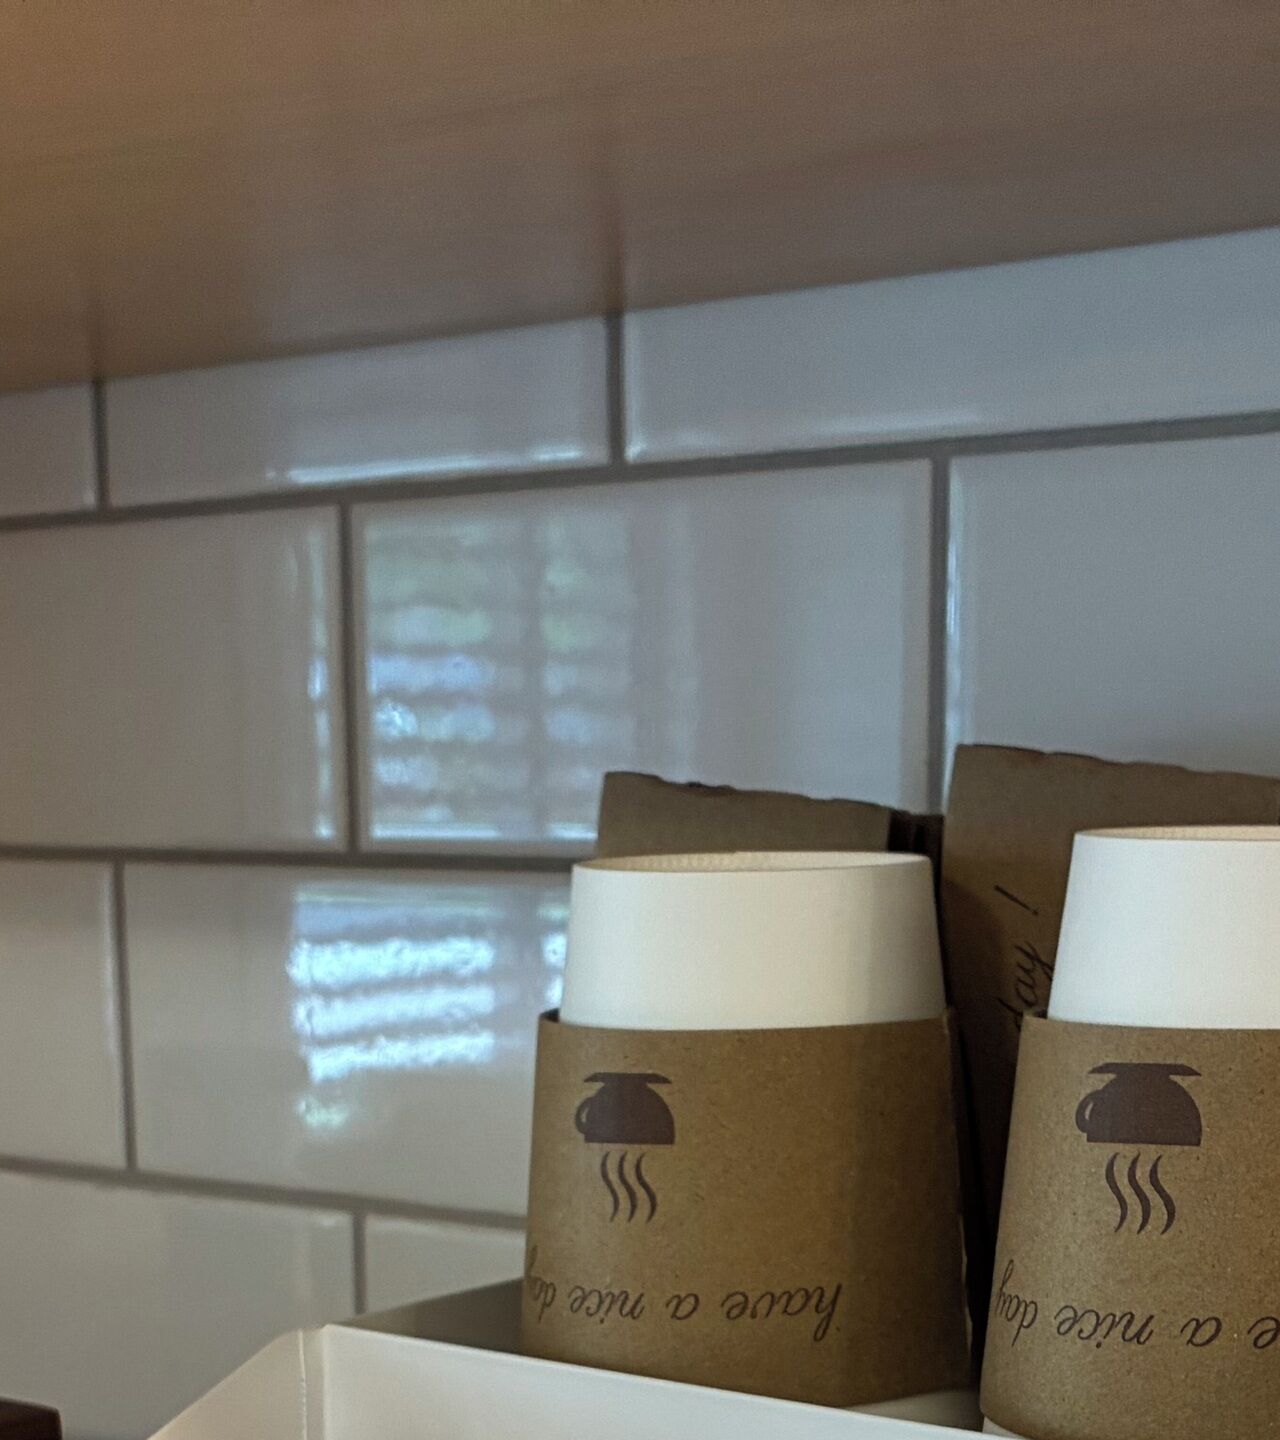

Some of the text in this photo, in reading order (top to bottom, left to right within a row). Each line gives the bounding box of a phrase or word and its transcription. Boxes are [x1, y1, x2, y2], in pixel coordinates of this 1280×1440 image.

[568, 1284, 645, 1325] nice
[664, 1291, 701, 1321] a
[726, 1282, 843, 1343] have
[995, 1259, 1038, 1346] day
[1056, 1305, 1154, 1349] nice
[1180, 1316, 1221, 1348] a
